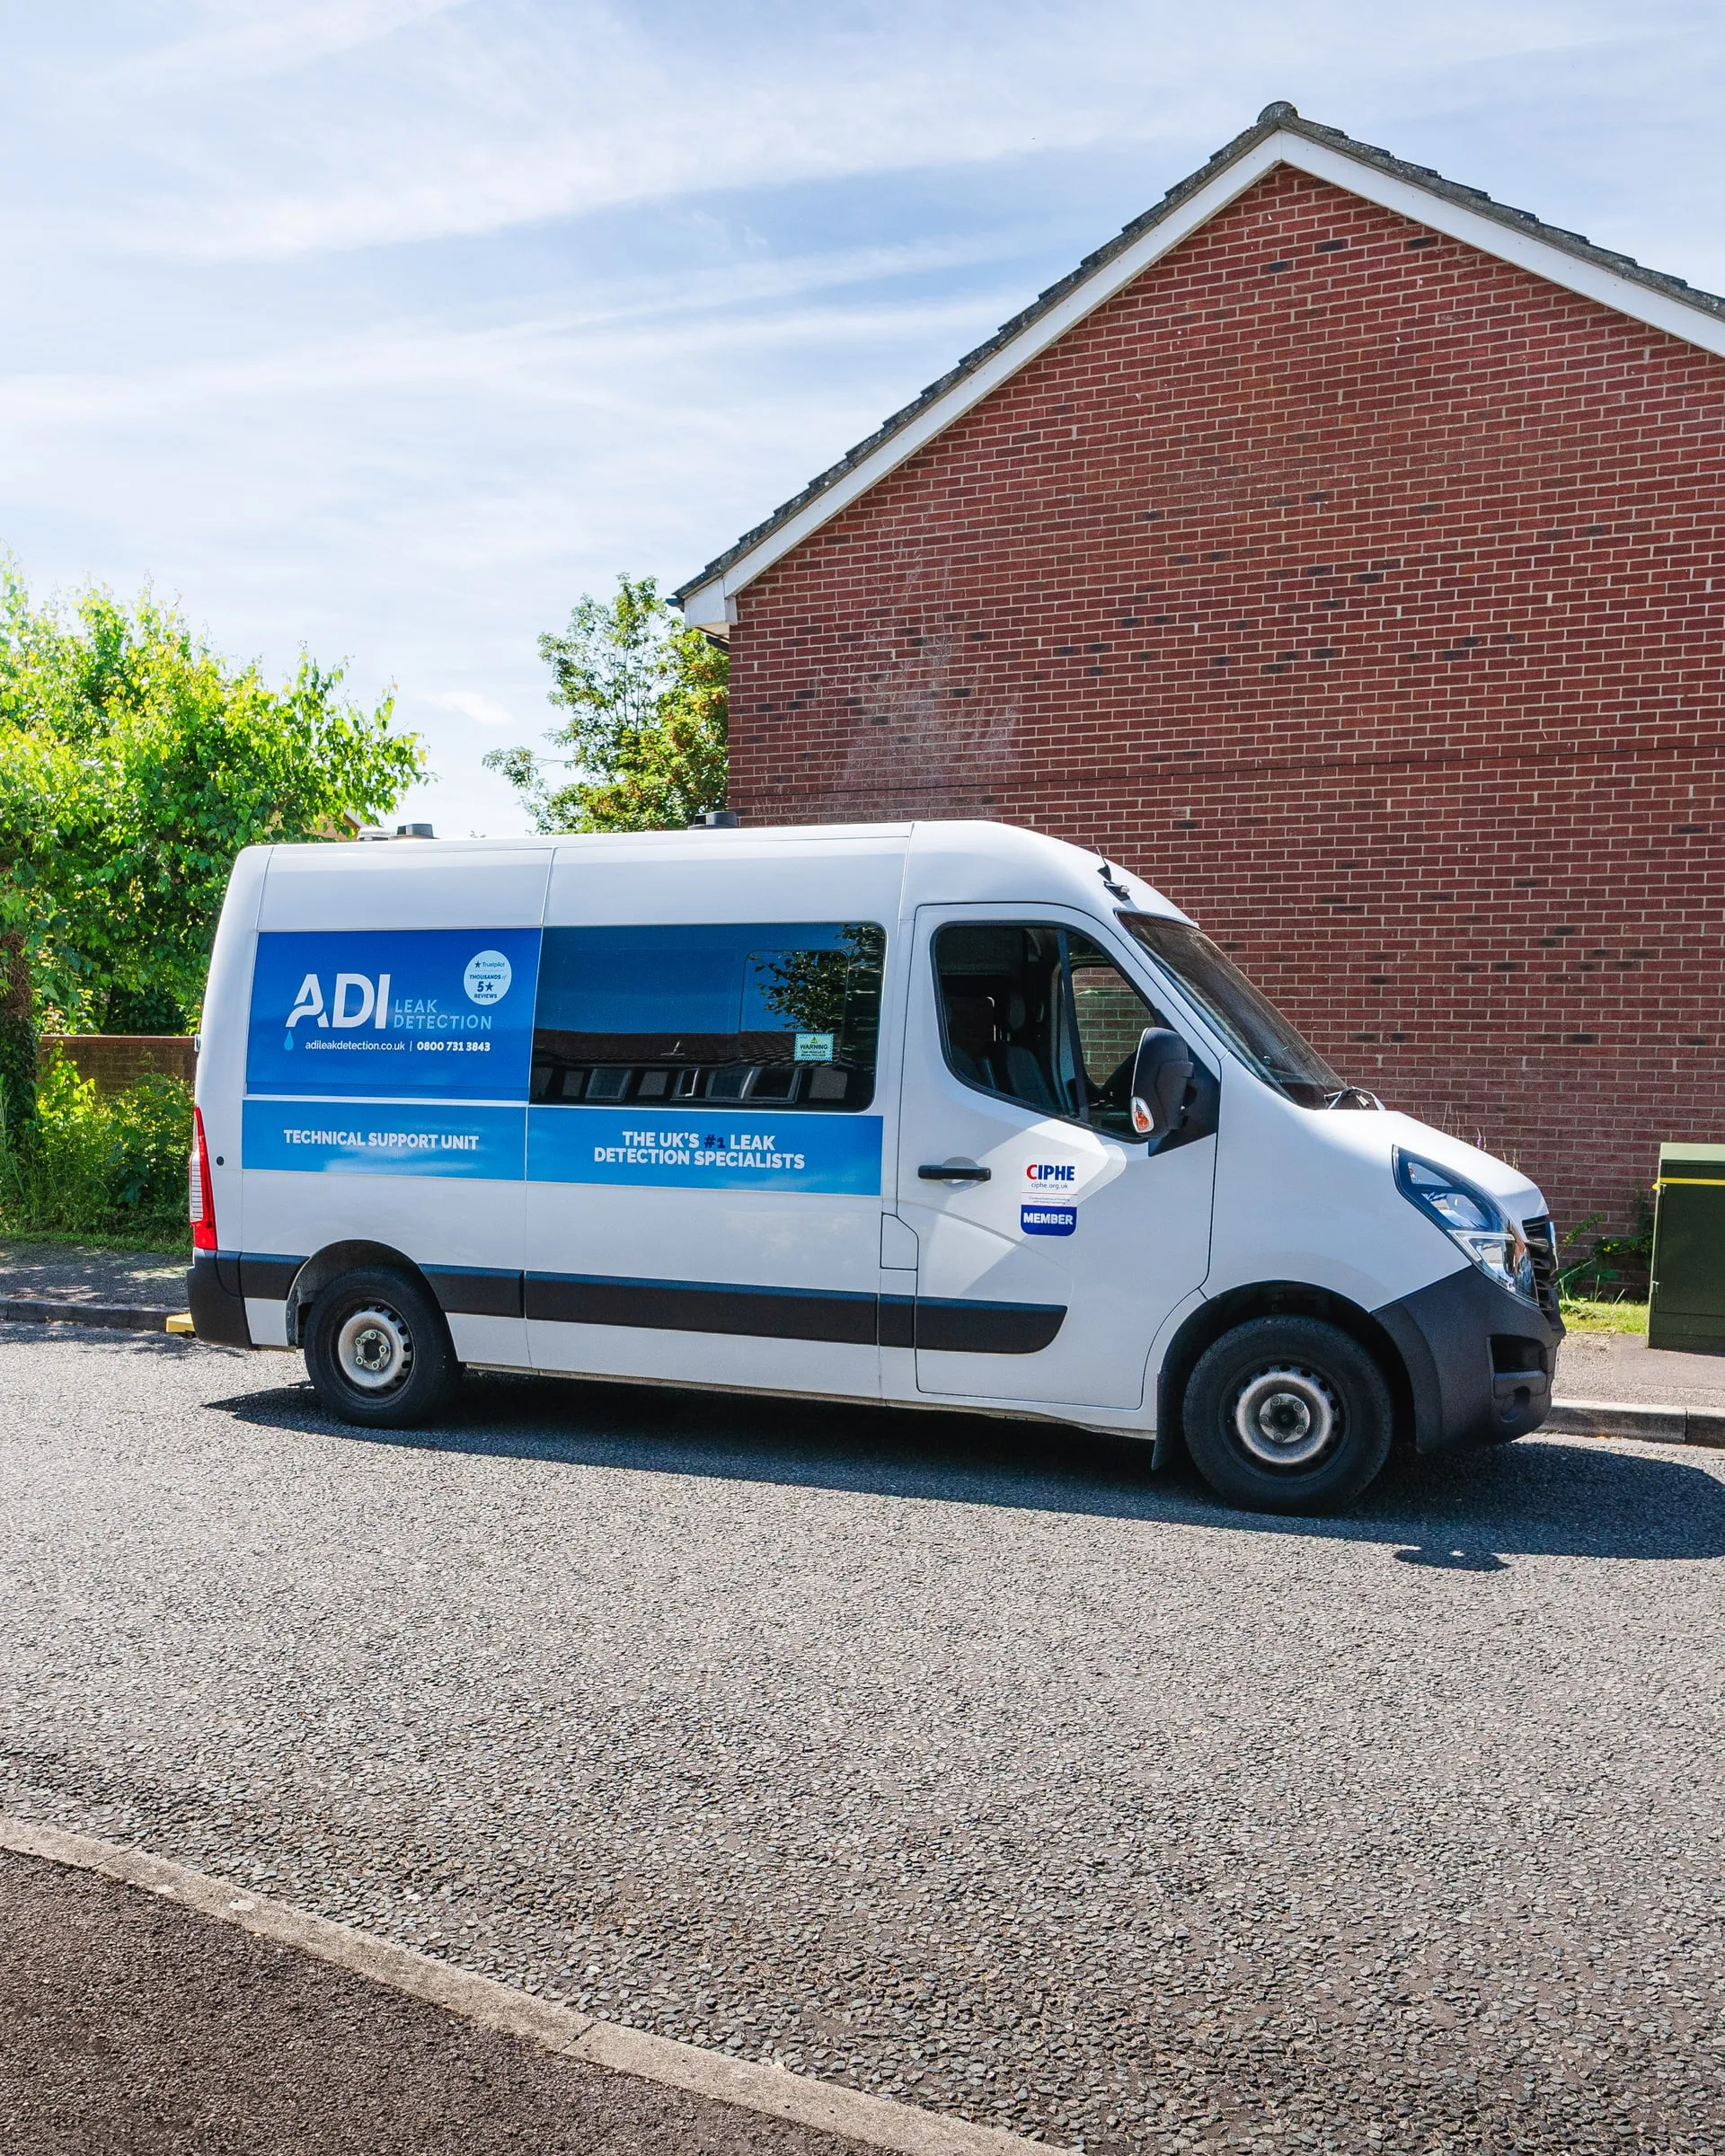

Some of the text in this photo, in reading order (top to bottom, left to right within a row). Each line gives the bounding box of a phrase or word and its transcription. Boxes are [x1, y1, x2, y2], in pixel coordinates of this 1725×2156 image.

[477, 981, 484, 993] 5
[285, 973, 391, 1029] ADI
[395, 999, 438, 1013] LEAK
[394, 1014, 492, 1029] DETECTION
[305, 1040, 491, 1052] adileakdetection.co.uk 0800 731 3843
[283, 1129, 479, 1150] TECHNICAL SUPPORT UNIT
[622, 1131, 775, 1151] THE UK'S #1 LEAK
[594, 1147, 806, 1169] DETECTION SPECIALISTS
[1026, 1164, 1075, 1180] CIPHE
[1031, 1181, 1068, 1190] ciphe.org.uk
[1023, 1212, 1074, 1225] MEMBER
